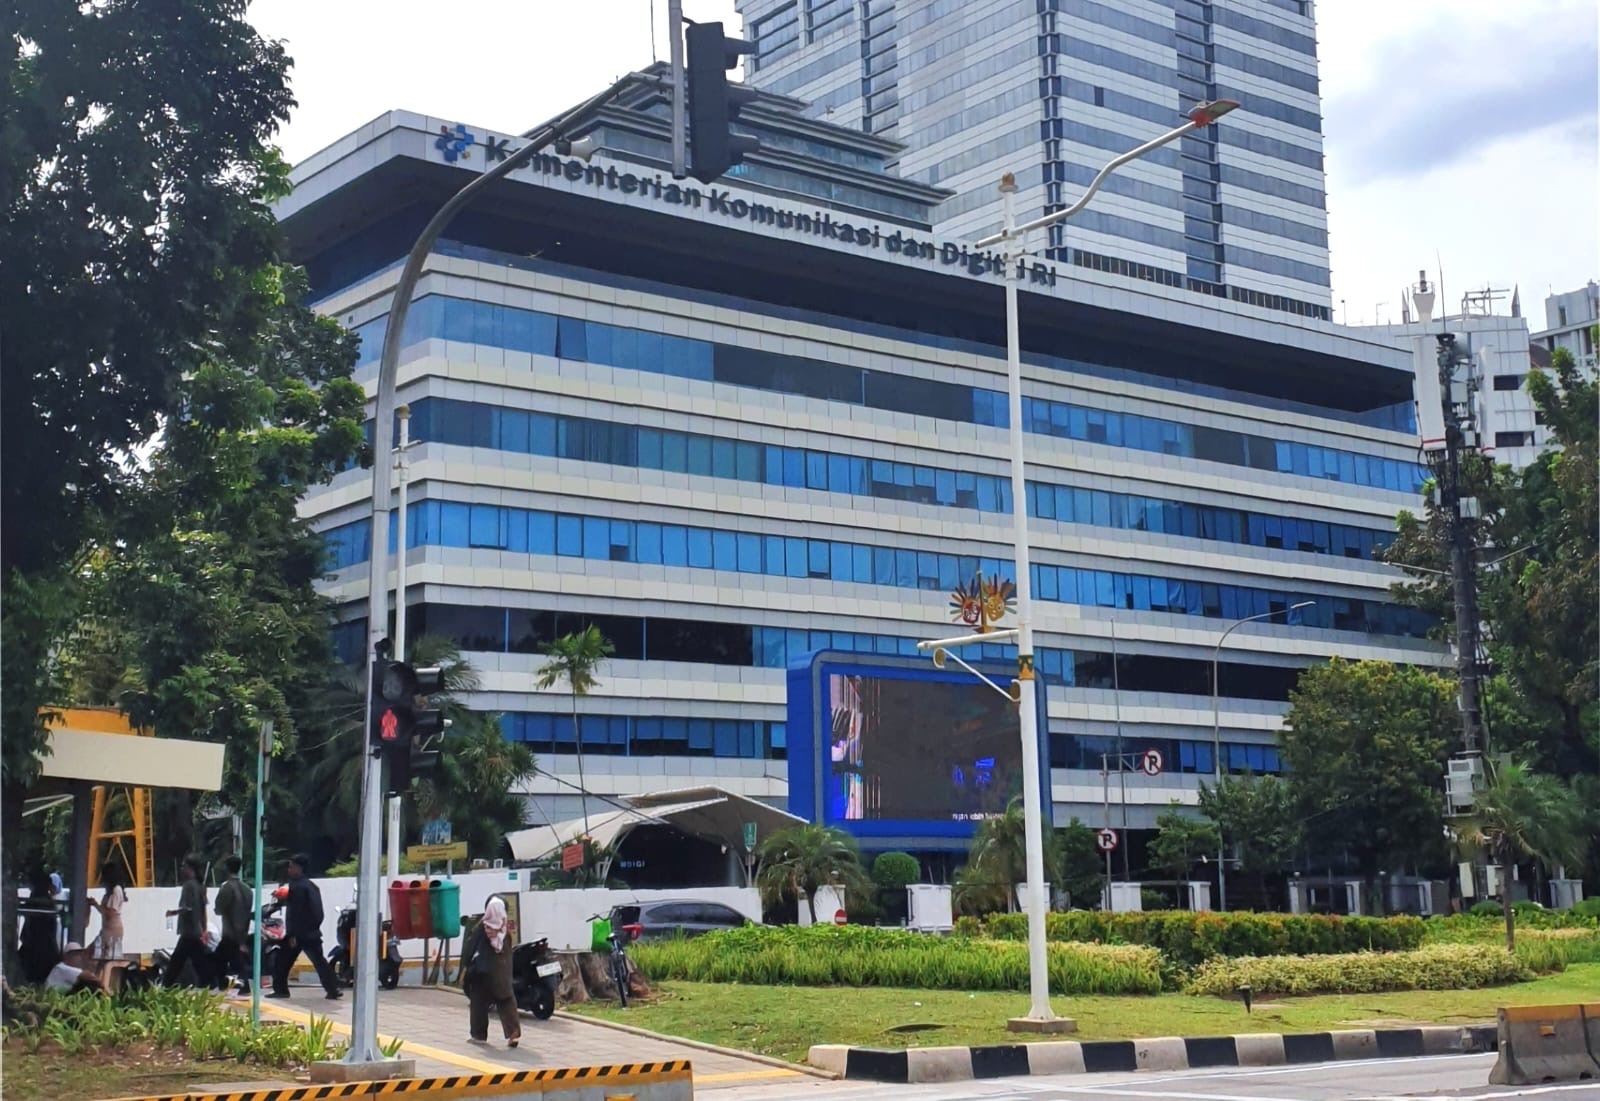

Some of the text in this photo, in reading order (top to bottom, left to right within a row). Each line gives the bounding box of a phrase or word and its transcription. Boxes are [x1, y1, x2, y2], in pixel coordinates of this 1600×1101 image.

[709, 188, 879, 248] Komunikasi
[885, 230, 935, 260] dan
[940, 242, 1025, 280] Digitl
[1030, 262, 1056, 287] RI
